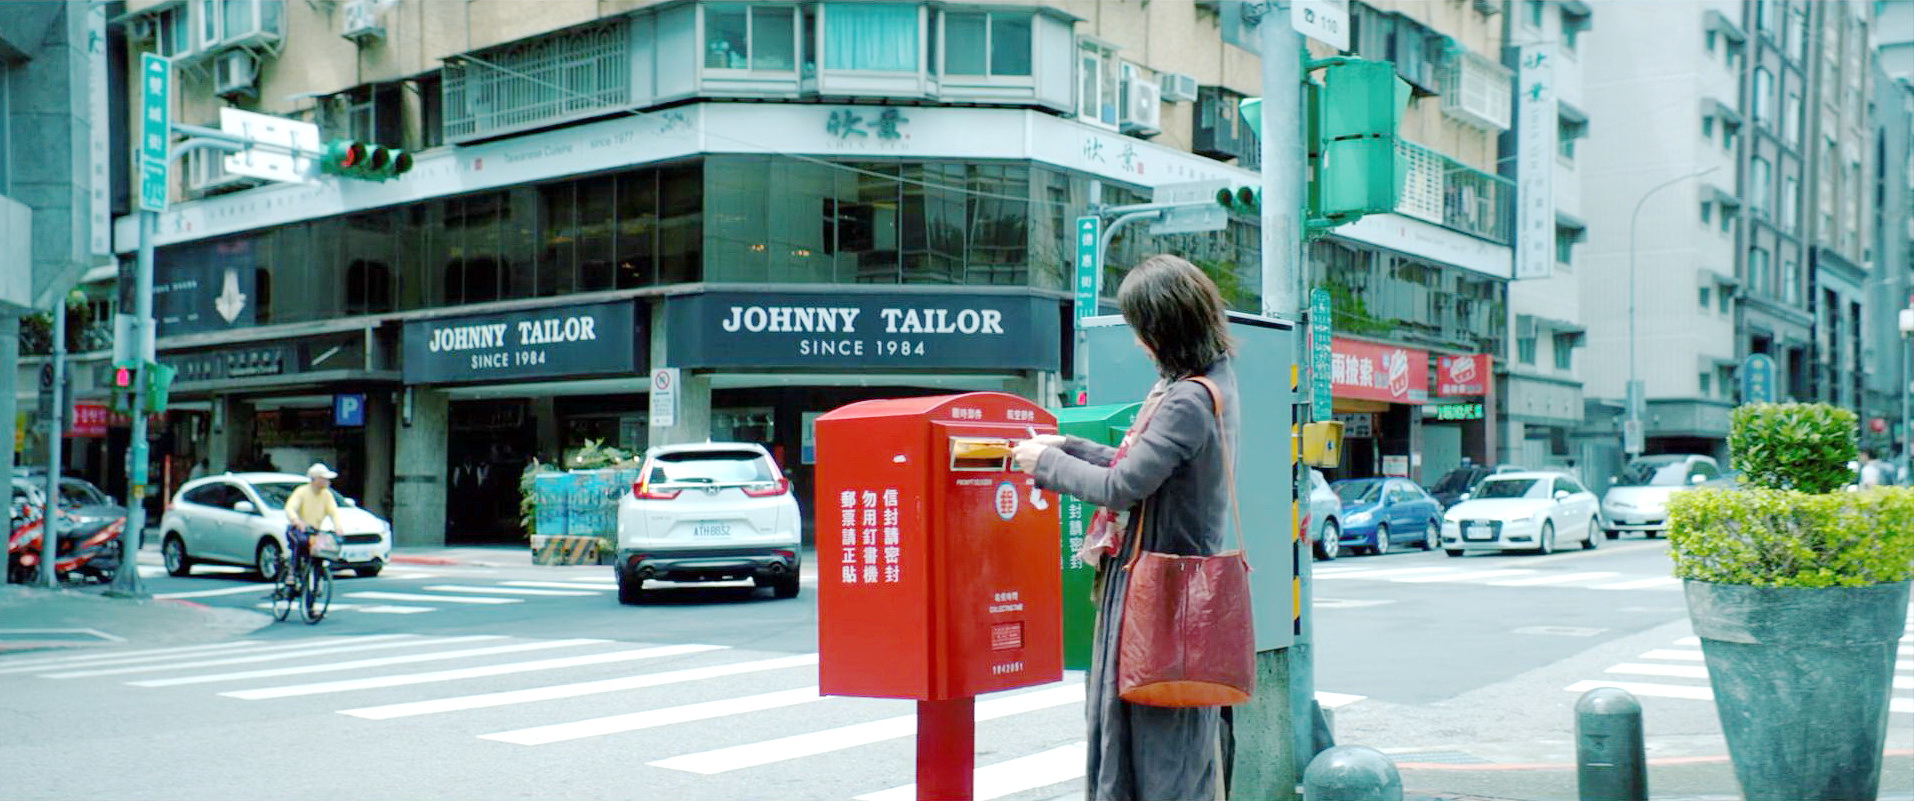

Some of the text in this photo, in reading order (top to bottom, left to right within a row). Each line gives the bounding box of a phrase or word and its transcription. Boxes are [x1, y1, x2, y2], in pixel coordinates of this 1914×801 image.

[429, 316, 596, 352] JOHNNY TAILOR
[722, 306, 1004, 334] JOHNNY TAILOR
[471, 350, 546, 369] SINCE 1984
[800, 340, 925, 355] SINCE 1984
[342, 397, 358, 419] P
[841, 491, 857, 583] 郵票請正貼
[862, 490, 878, 583] 勿用釘書機
[882, 489, 899, 583] 信封請密封
